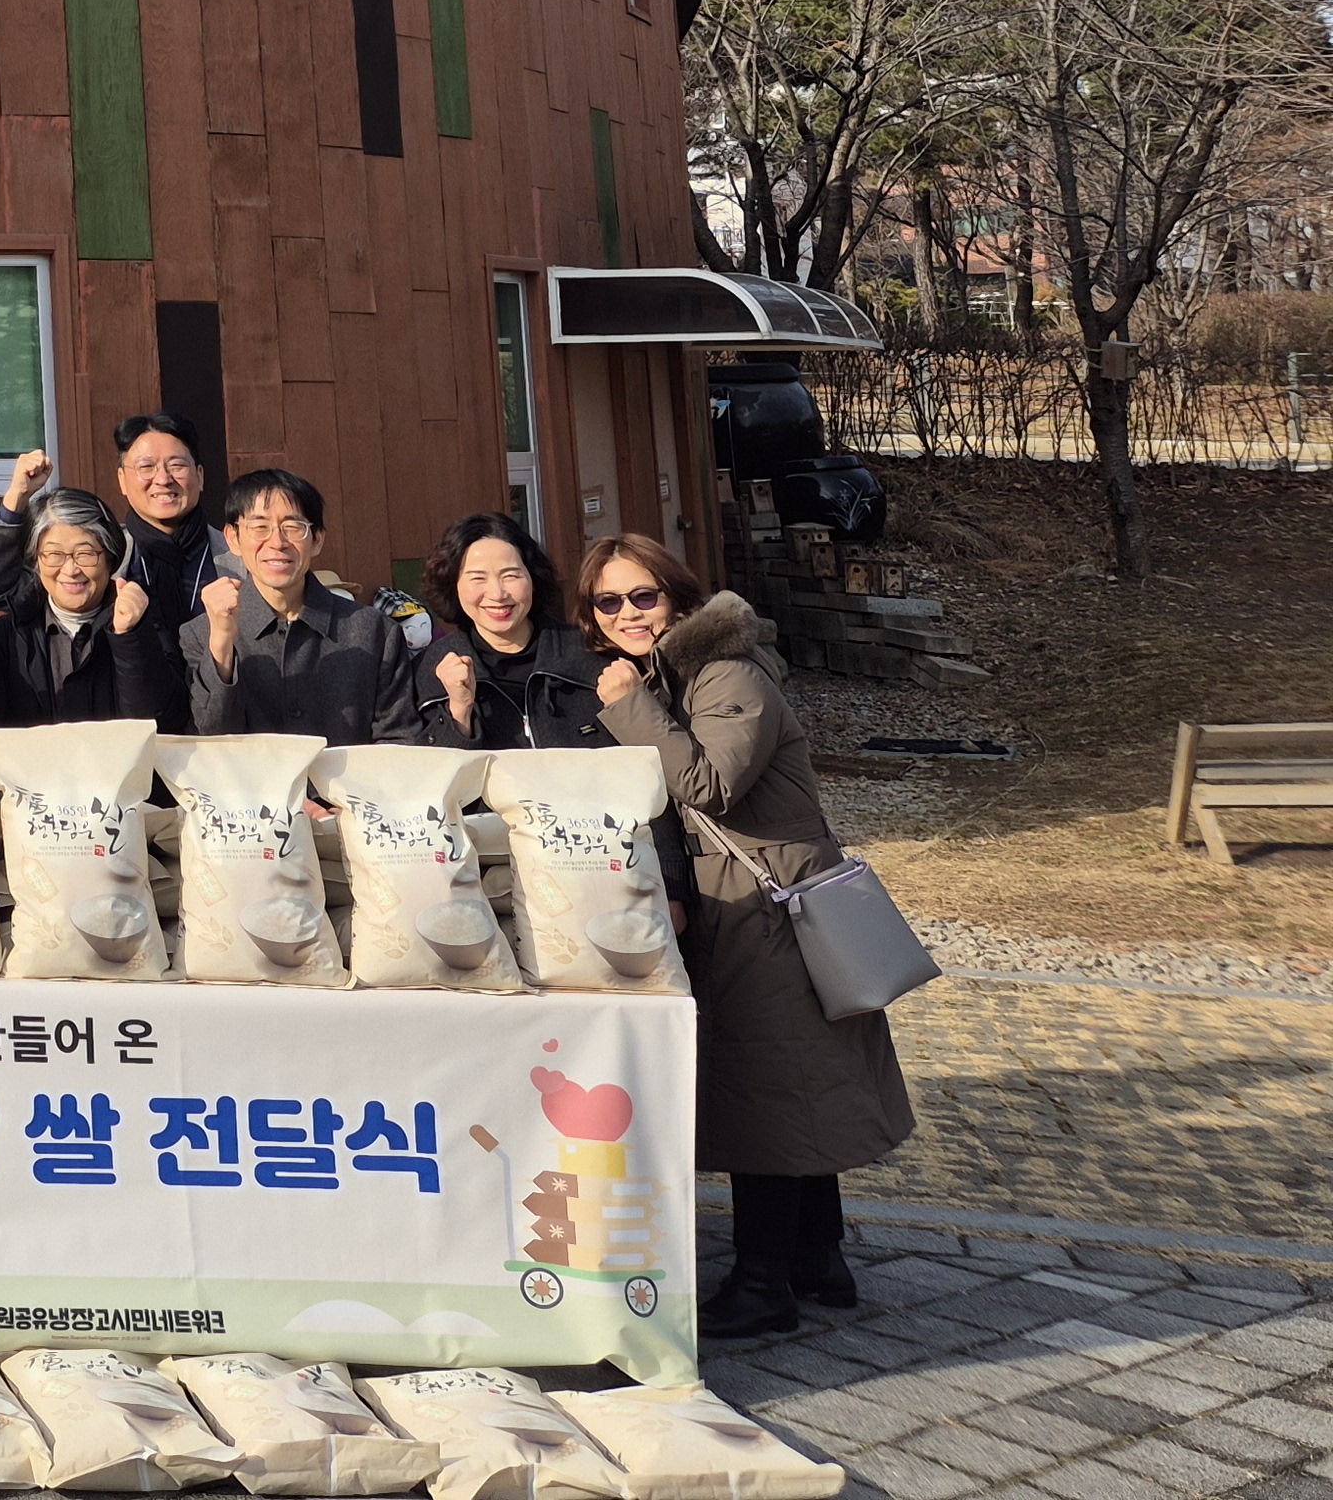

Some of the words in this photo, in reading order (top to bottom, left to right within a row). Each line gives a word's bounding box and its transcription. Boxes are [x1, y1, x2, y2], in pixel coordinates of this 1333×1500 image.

[113, 1019, 158, 1065] 온
[24, 1092, 121, 1186] 쌀
[148, 1095, 441, 1194] 전달식
